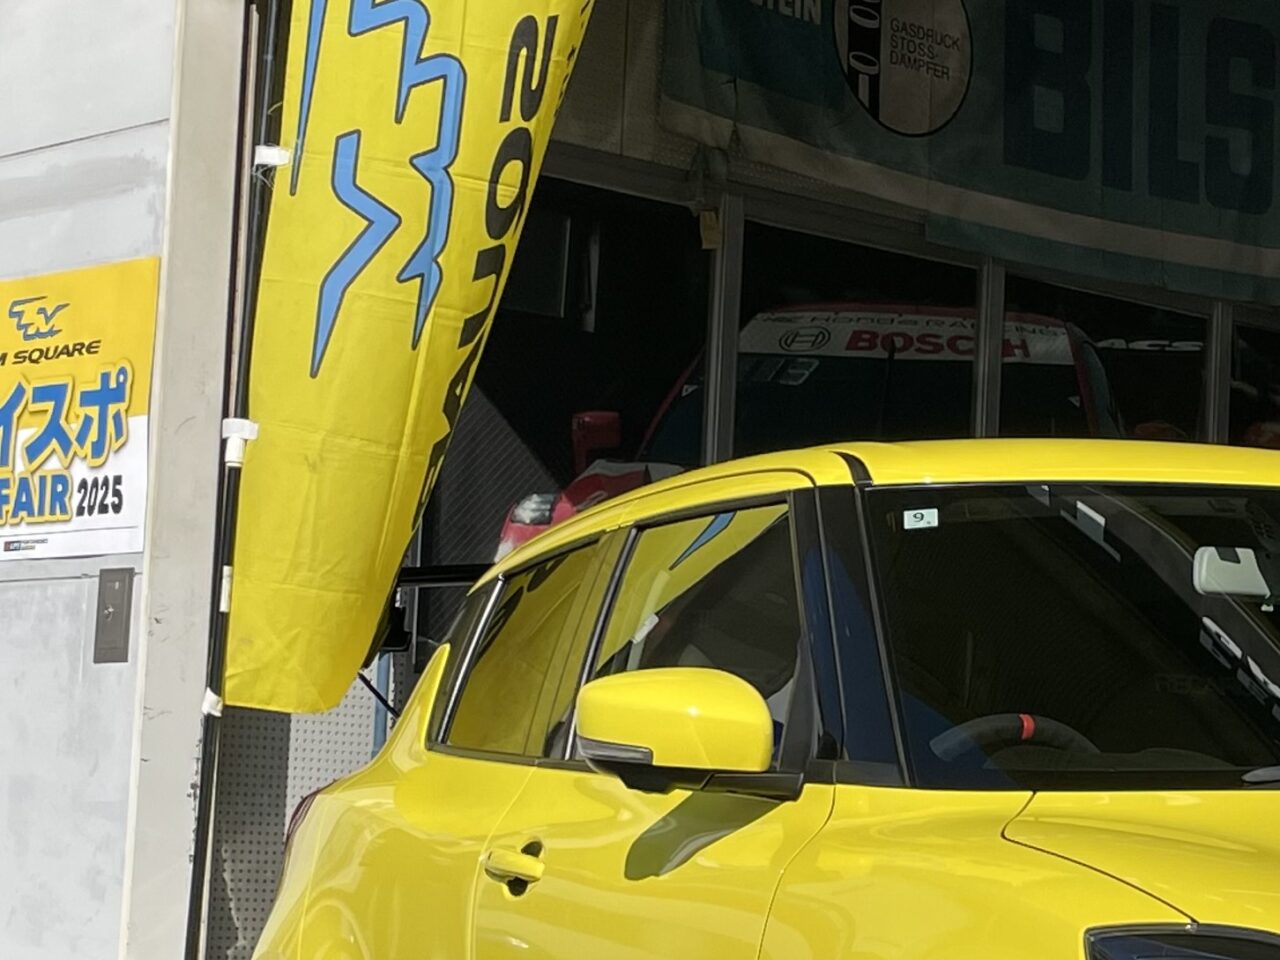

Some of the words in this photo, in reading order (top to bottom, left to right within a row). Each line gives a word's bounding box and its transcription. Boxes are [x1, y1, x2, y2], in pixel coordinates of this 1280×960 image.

[890, 18, 960, 51] GASDRUCK
[12, 339, 101, 366] SQUARE
[846, 330, 1030, 358] BOSCH
[0, 473, 70, 518] FAIR
[76, 474, 123, 517] 2025
